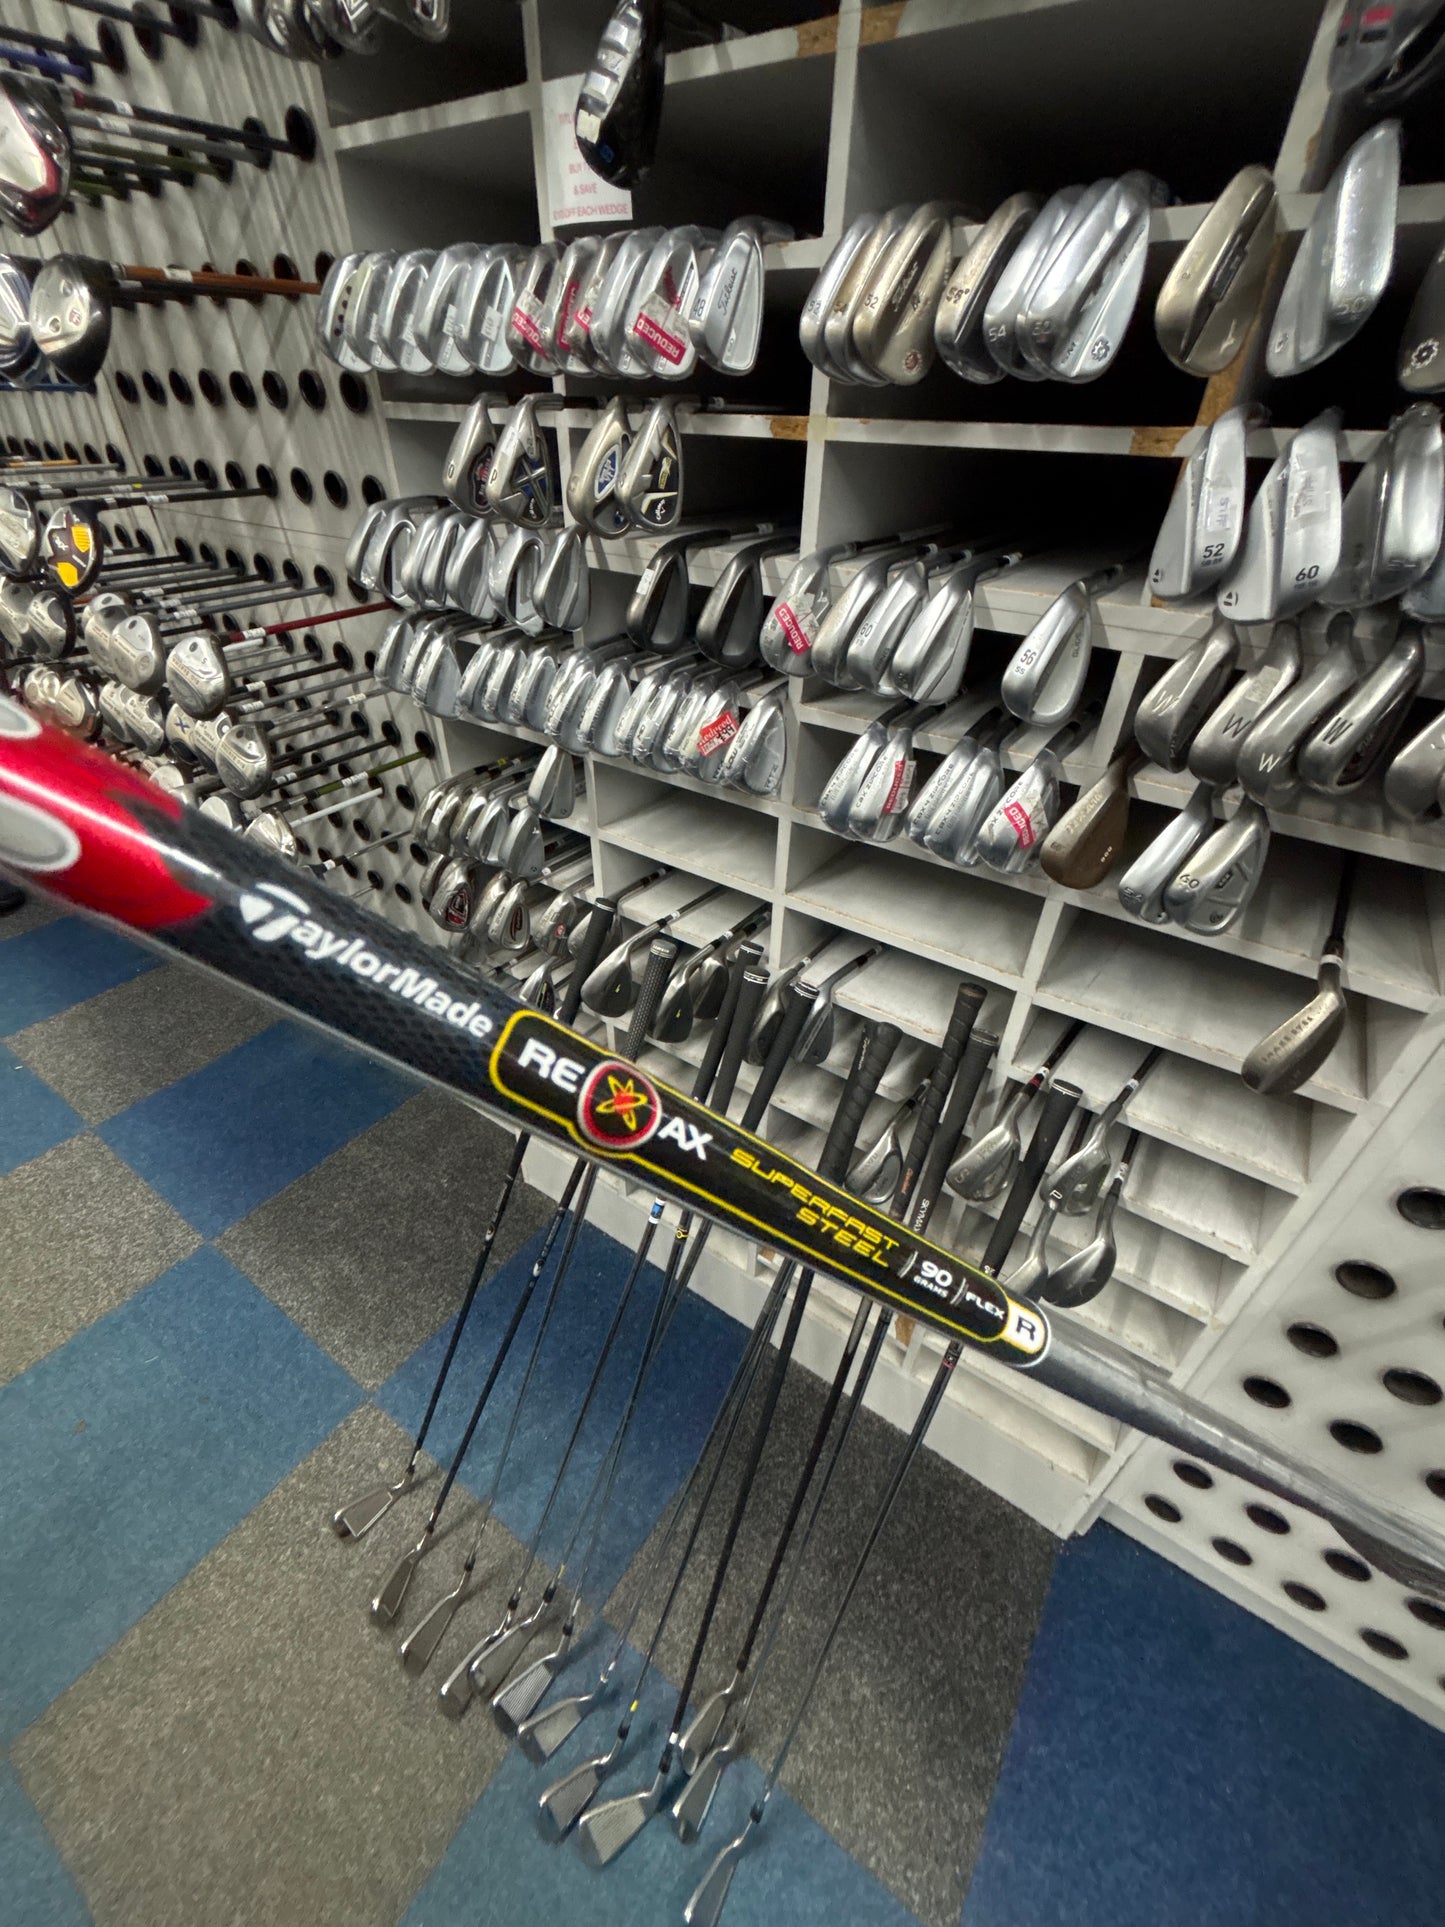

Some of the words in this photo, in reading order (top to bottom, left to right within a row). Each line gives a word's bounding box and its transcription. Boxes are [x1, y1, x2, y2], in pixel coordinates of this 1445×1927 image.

[579, 182, 597, 194] SAVE
[577, 205, 598, 216] EACH
[599, 203, 628, 215] WEDGE
[864, 294, 879, 309] 52
[636, 317, 681, 359] REDUCED
[989, 325, 1006, 342] 54
[1202, 542, 1225, 559] 52
[1295, 564, 1320, 582] 60
[778, 607, 804, 651] REDUCED
[1020, 648, 1037, 666] 56
[1152, 690, 1180, 717] W
[1221, 712, 1252, 739] W
[1322, 716, 1353, 744] W
[725, 747, 739, 770] LOW
[1258, 752, 1281, 773] W
[865, 755, 889, 791] ZIPCORE
[928, 763, 955, 799] ZIPCORE
[1179, 874, 1200, 889] 60
[240, 882, 493, 1038] TaylorMade
[517, 1036, 586, 1094] RE
[657, 1115, 714, 1161] AX
[729, 1147, 901, 1250] SUPERFAST
[795, 1206, 890, 1268] STEEL
[913, 1274, 949, 1299] GRAMS
[920, 1260, 953, 1288] 90
[965, 1291, 1006, 1320] FLEX
[1015, 1315, 1037, 1342] R
